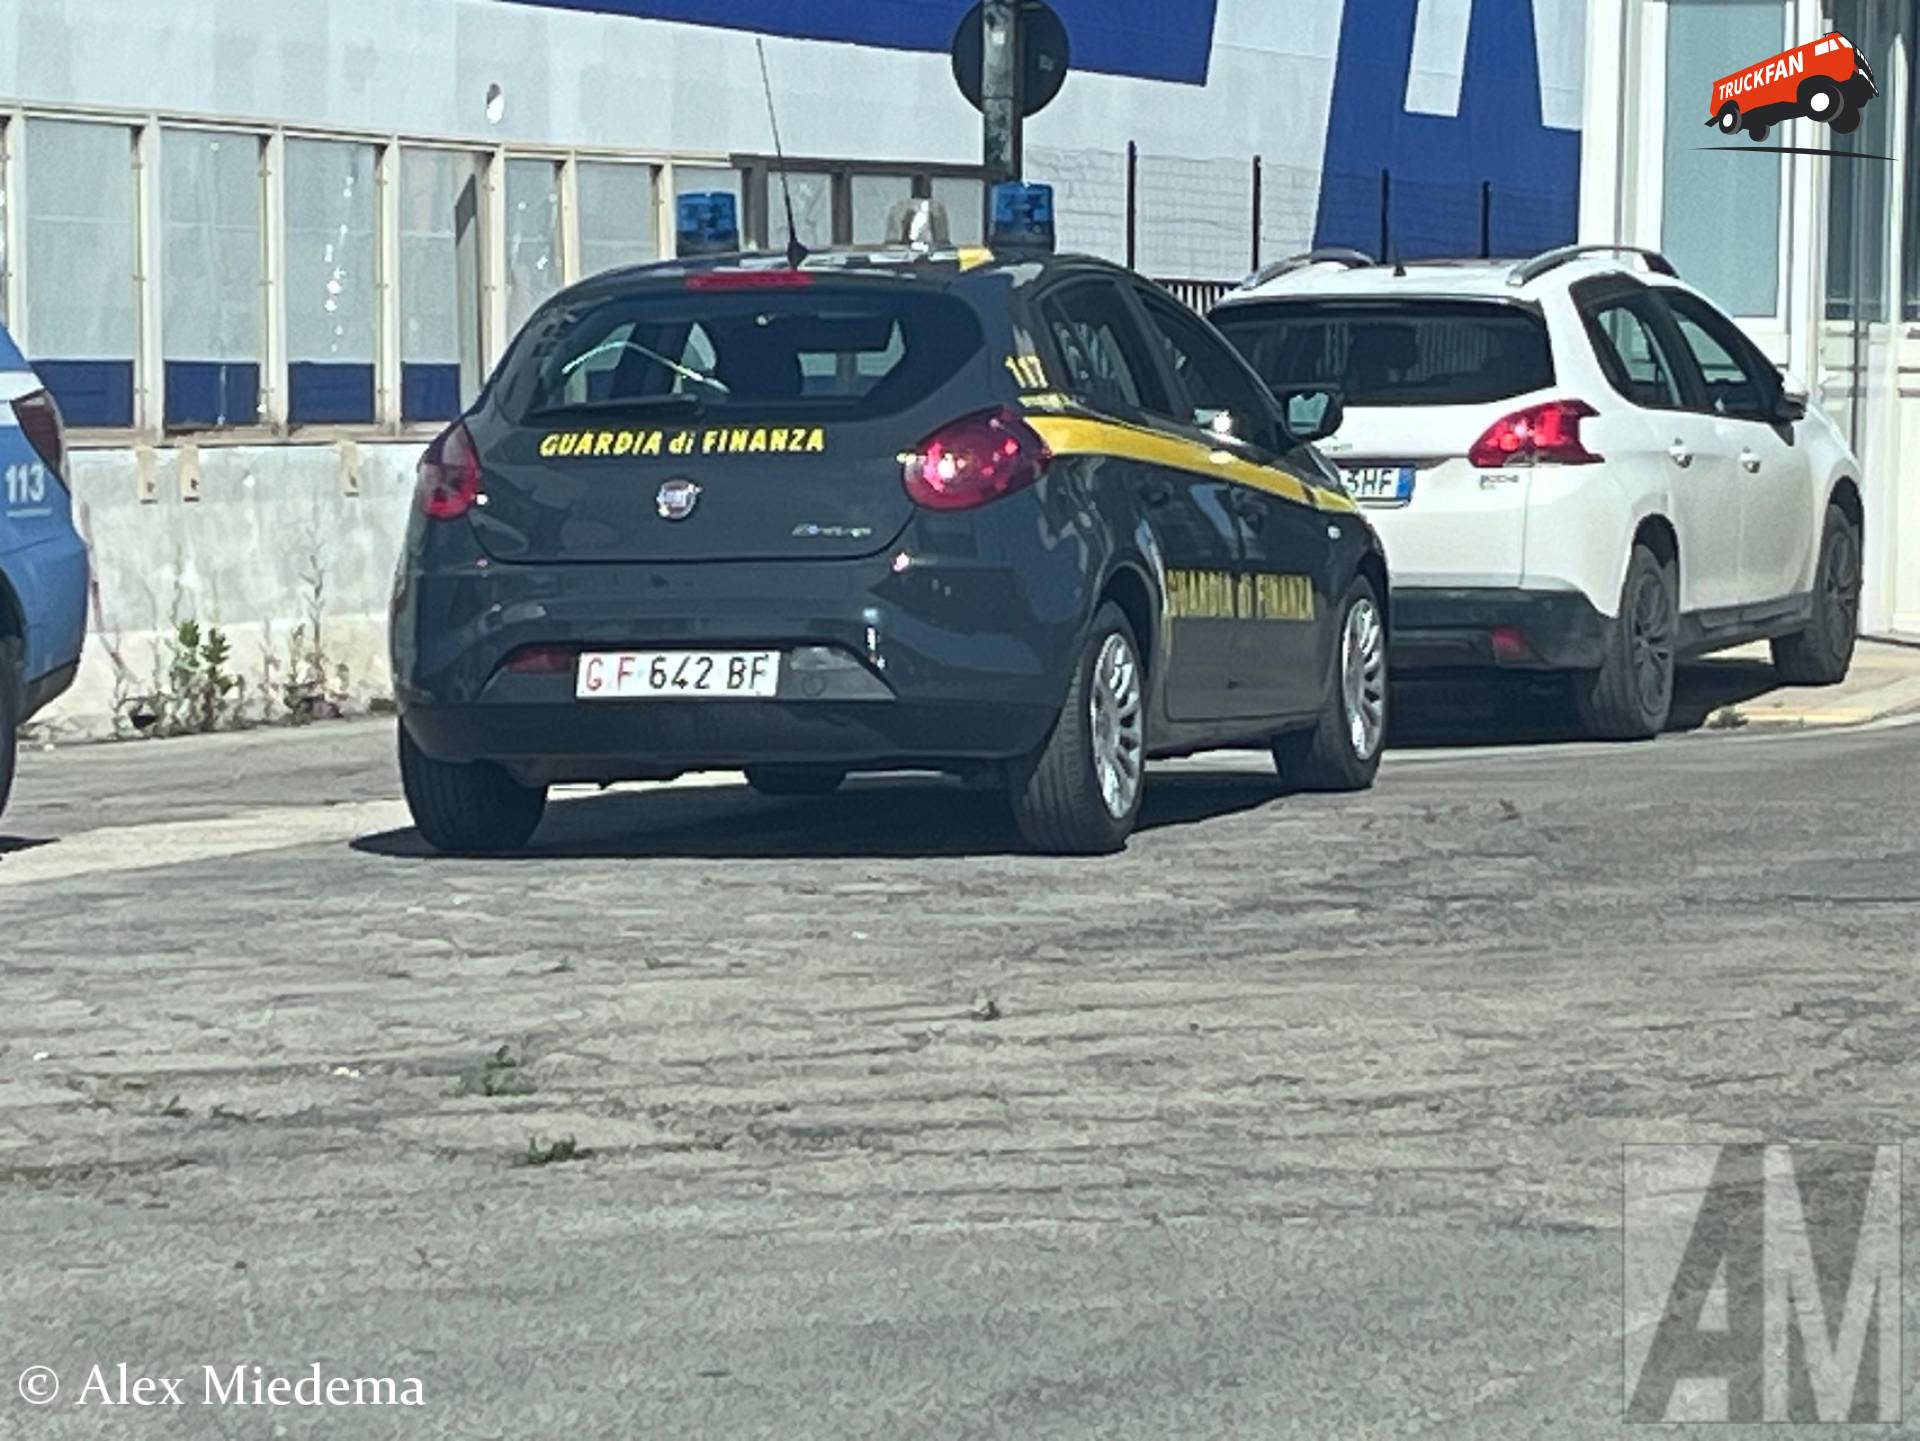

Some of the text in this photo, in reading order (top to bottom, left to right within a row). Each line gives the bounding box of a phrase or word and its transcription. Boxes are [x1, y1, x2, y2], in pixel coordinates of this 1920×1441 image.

[539, 428, 825, 456] GUARDIA di FINANZA
[5, 464, 45, 502] 113
[649, 655, 714, 690] 642
[726, 654, 770, 690] BF
